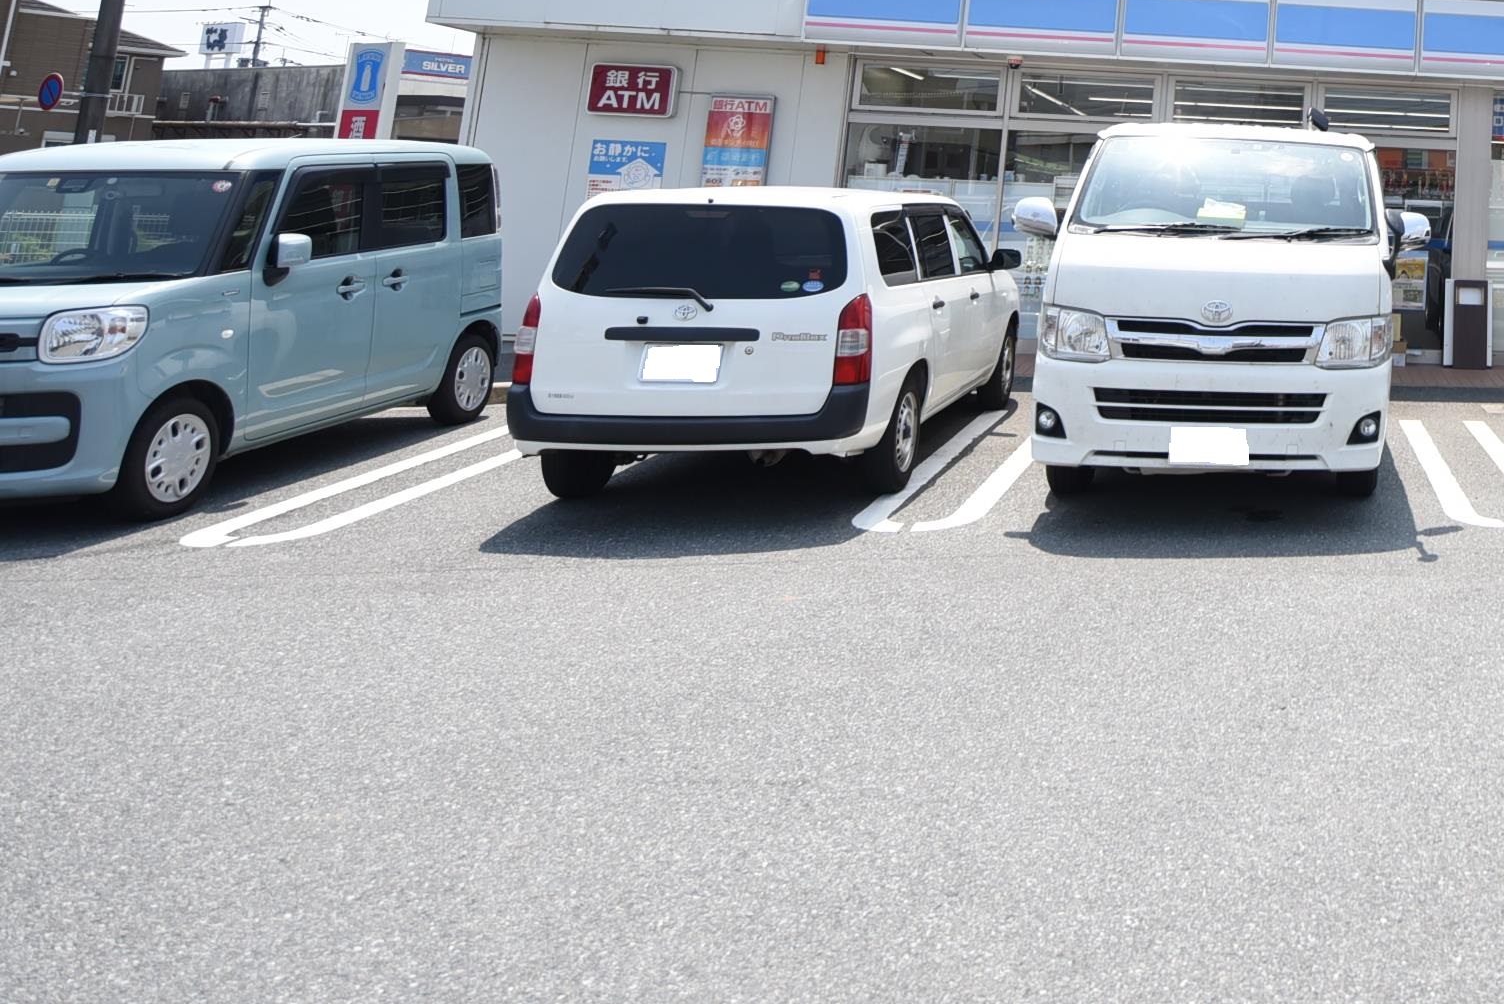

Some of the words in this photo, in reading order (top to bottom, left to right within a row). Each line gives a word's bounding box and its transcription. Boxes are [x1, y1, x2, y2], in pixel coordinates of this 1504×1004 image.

[422, 61, 466, 73] SILVER
[605, 70, 660, 89] 銀行
[597, 91, 661, 110] ATM
